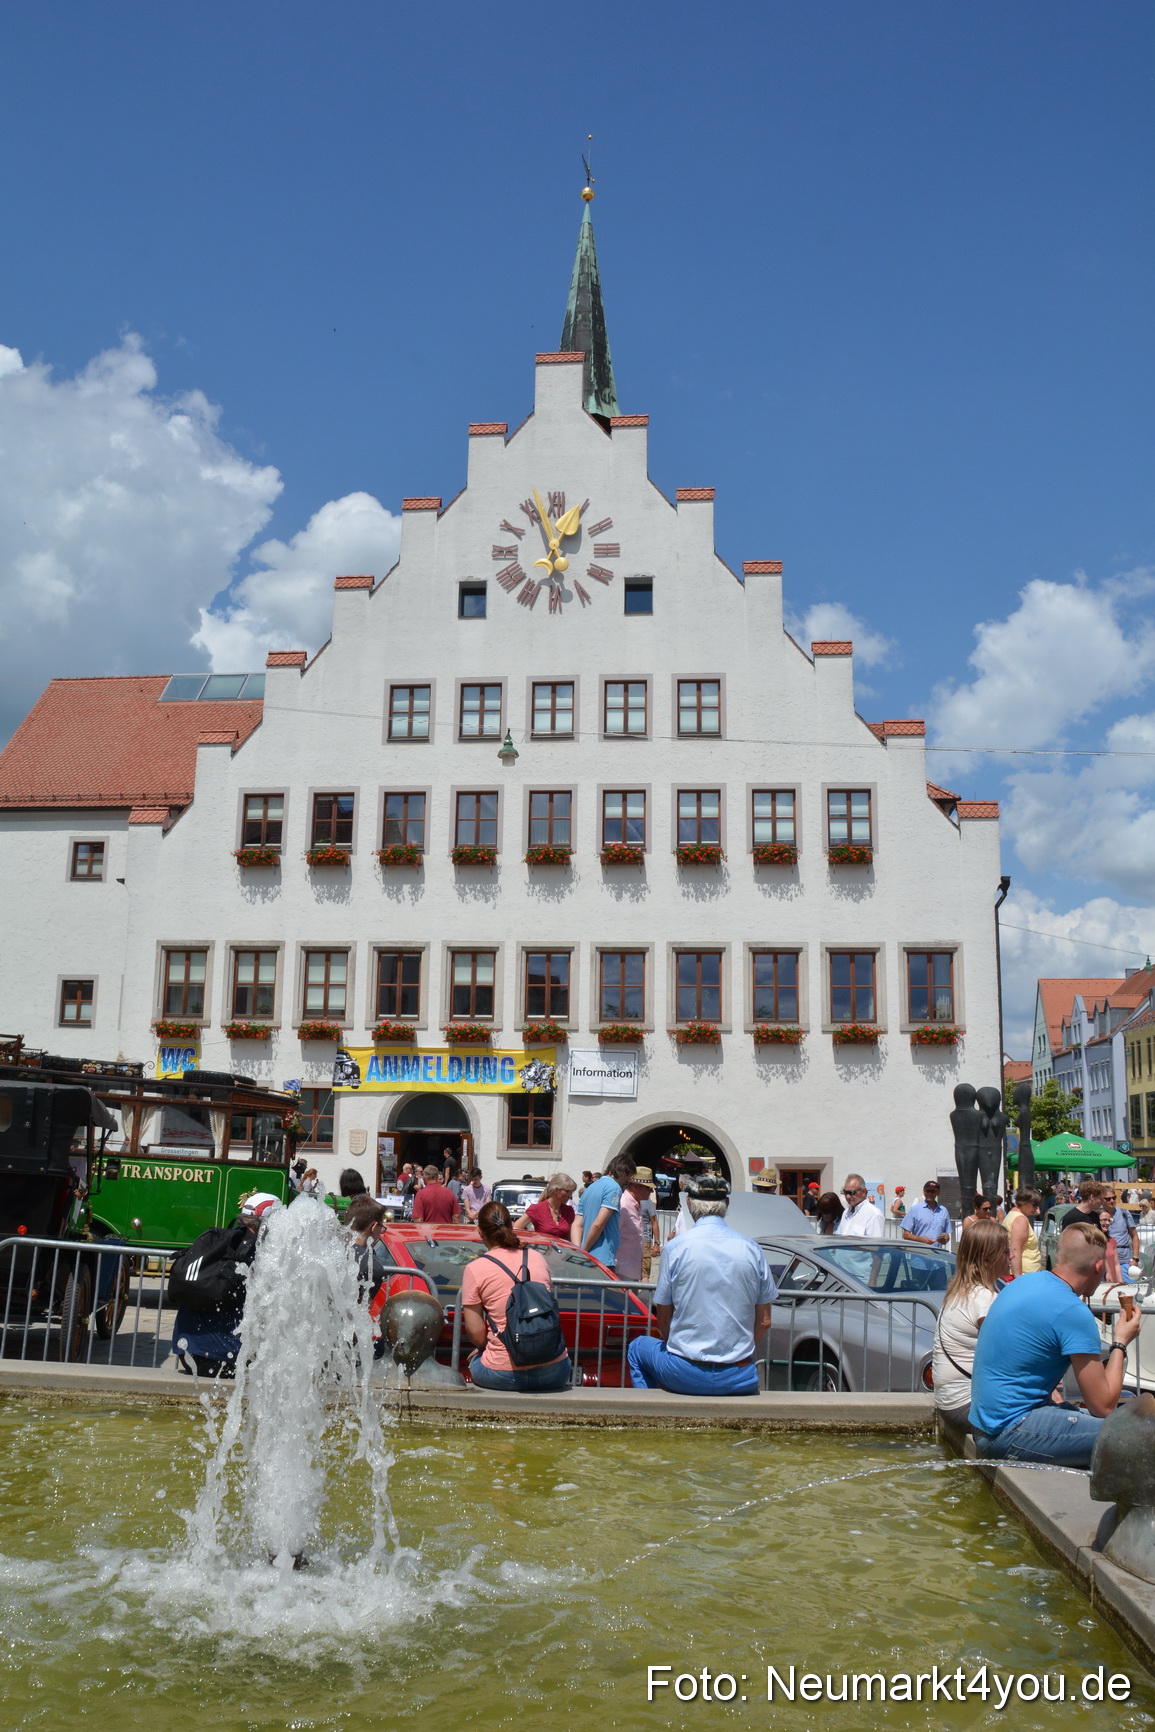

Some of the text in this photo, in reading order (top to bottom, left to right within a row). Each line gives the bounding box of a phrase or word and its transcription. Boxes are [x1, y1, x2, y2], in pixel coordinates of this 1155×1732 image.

[161, 1046, 197, 1073] WC
[365, 1054, 516, 1085] ANMELDUNG
[572, 1066, 633, 1080] Information
[121, 1163, 215, 1183] TRANSPORT
